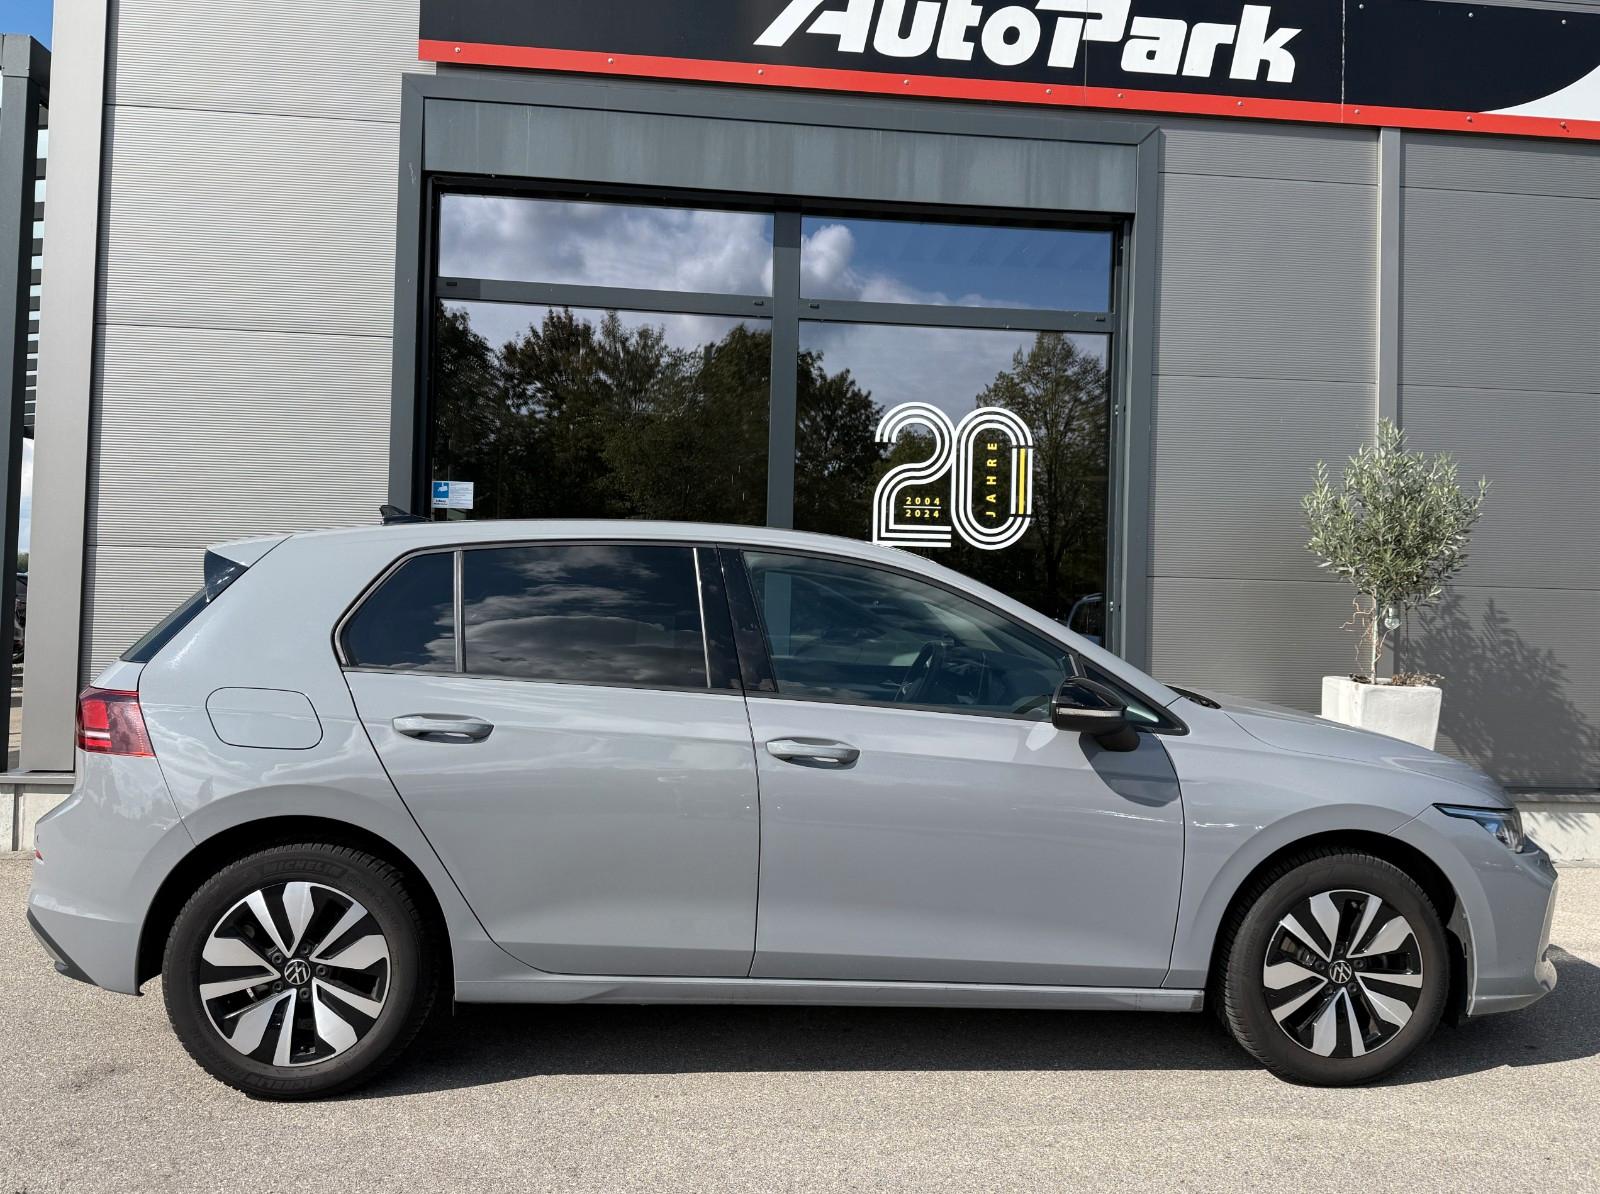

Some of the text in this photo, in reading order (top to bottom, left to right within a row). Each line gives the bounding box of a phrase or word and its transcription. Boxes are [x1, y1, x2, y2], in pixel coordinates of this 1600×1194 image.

[753, 0, 1302, 84] AutoPark
[872, 402, 1033, 550] 20
[905, 496, 940, 506] 2004
[905, 509, 940, 518] 2024
[986, 442, 998, 518] JAHRE
